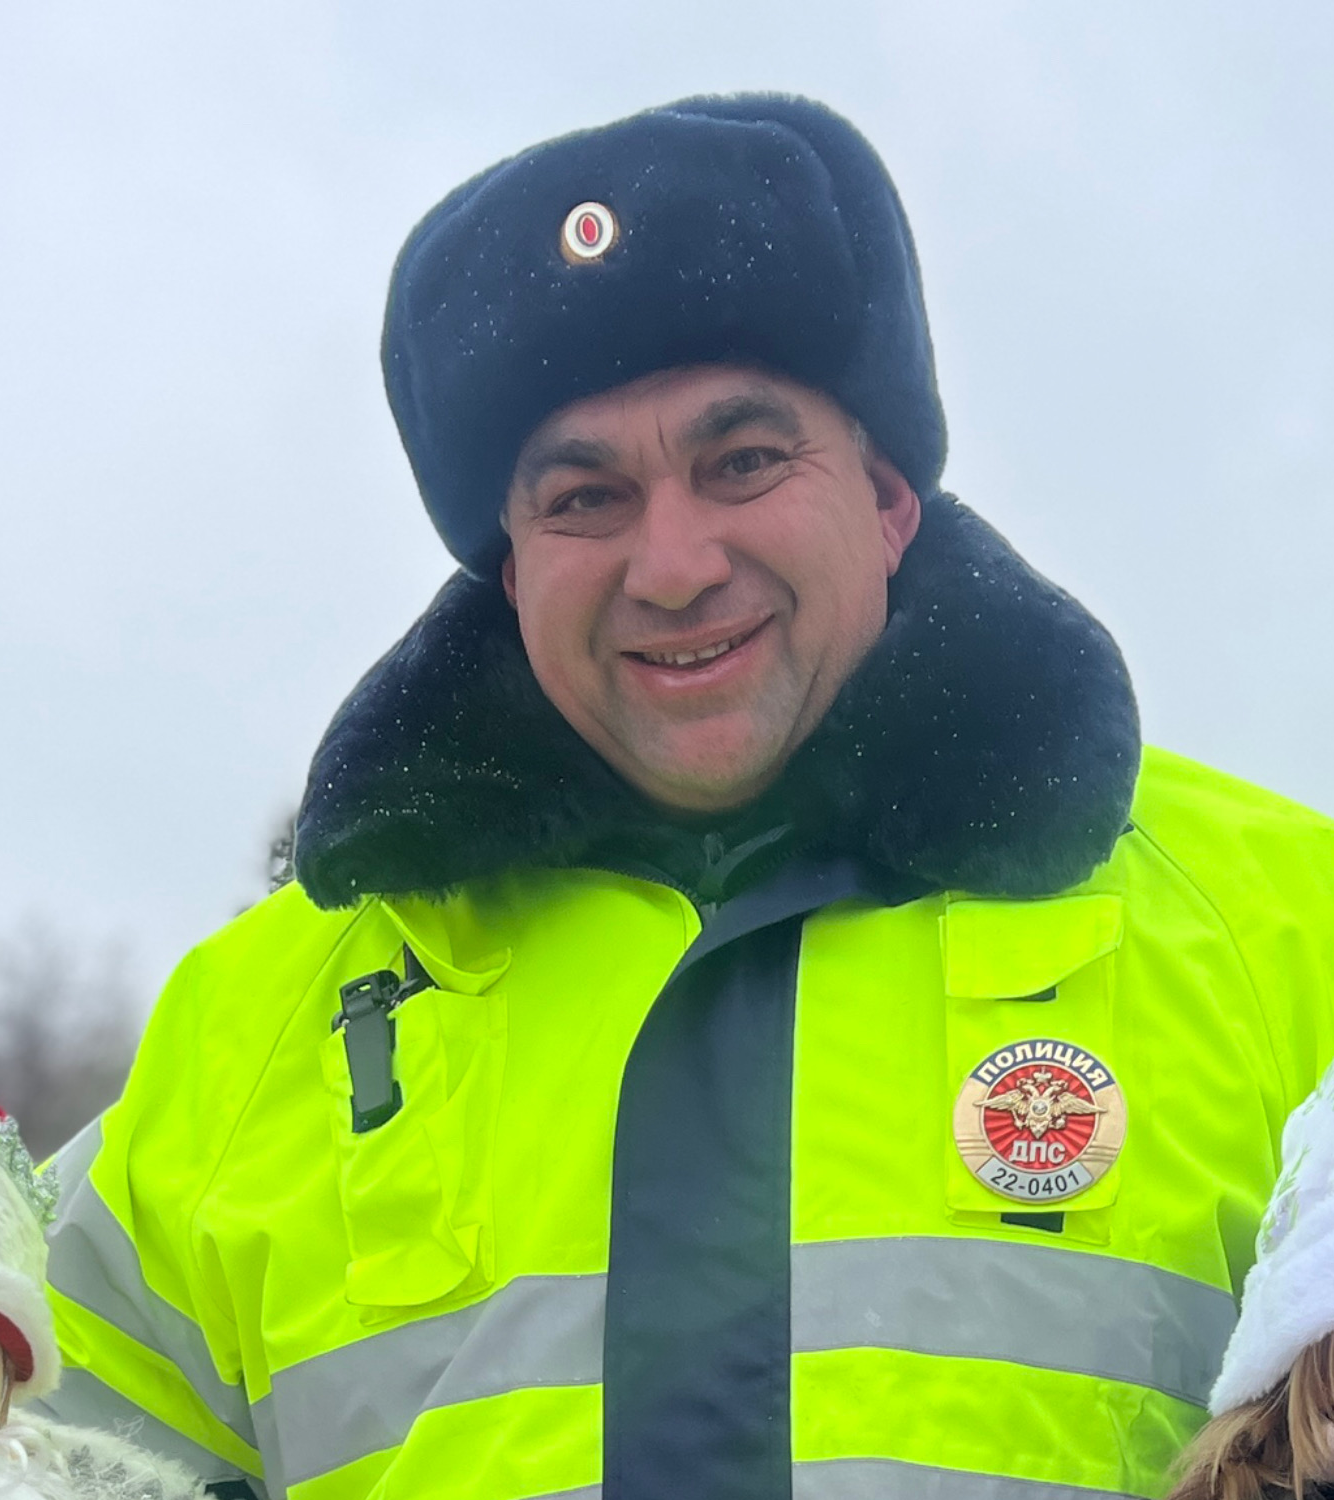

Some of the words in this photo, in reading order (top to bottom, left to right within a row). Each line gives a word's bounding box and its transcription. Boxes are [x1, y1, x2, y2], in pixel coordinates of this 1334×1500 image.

[977, 1041, 1108, 1087] ПОЛИЦИЯ
[1009, 1140, 1066, 1164] ДПС
[990, 1168, 1080, 1196] 22-0401
